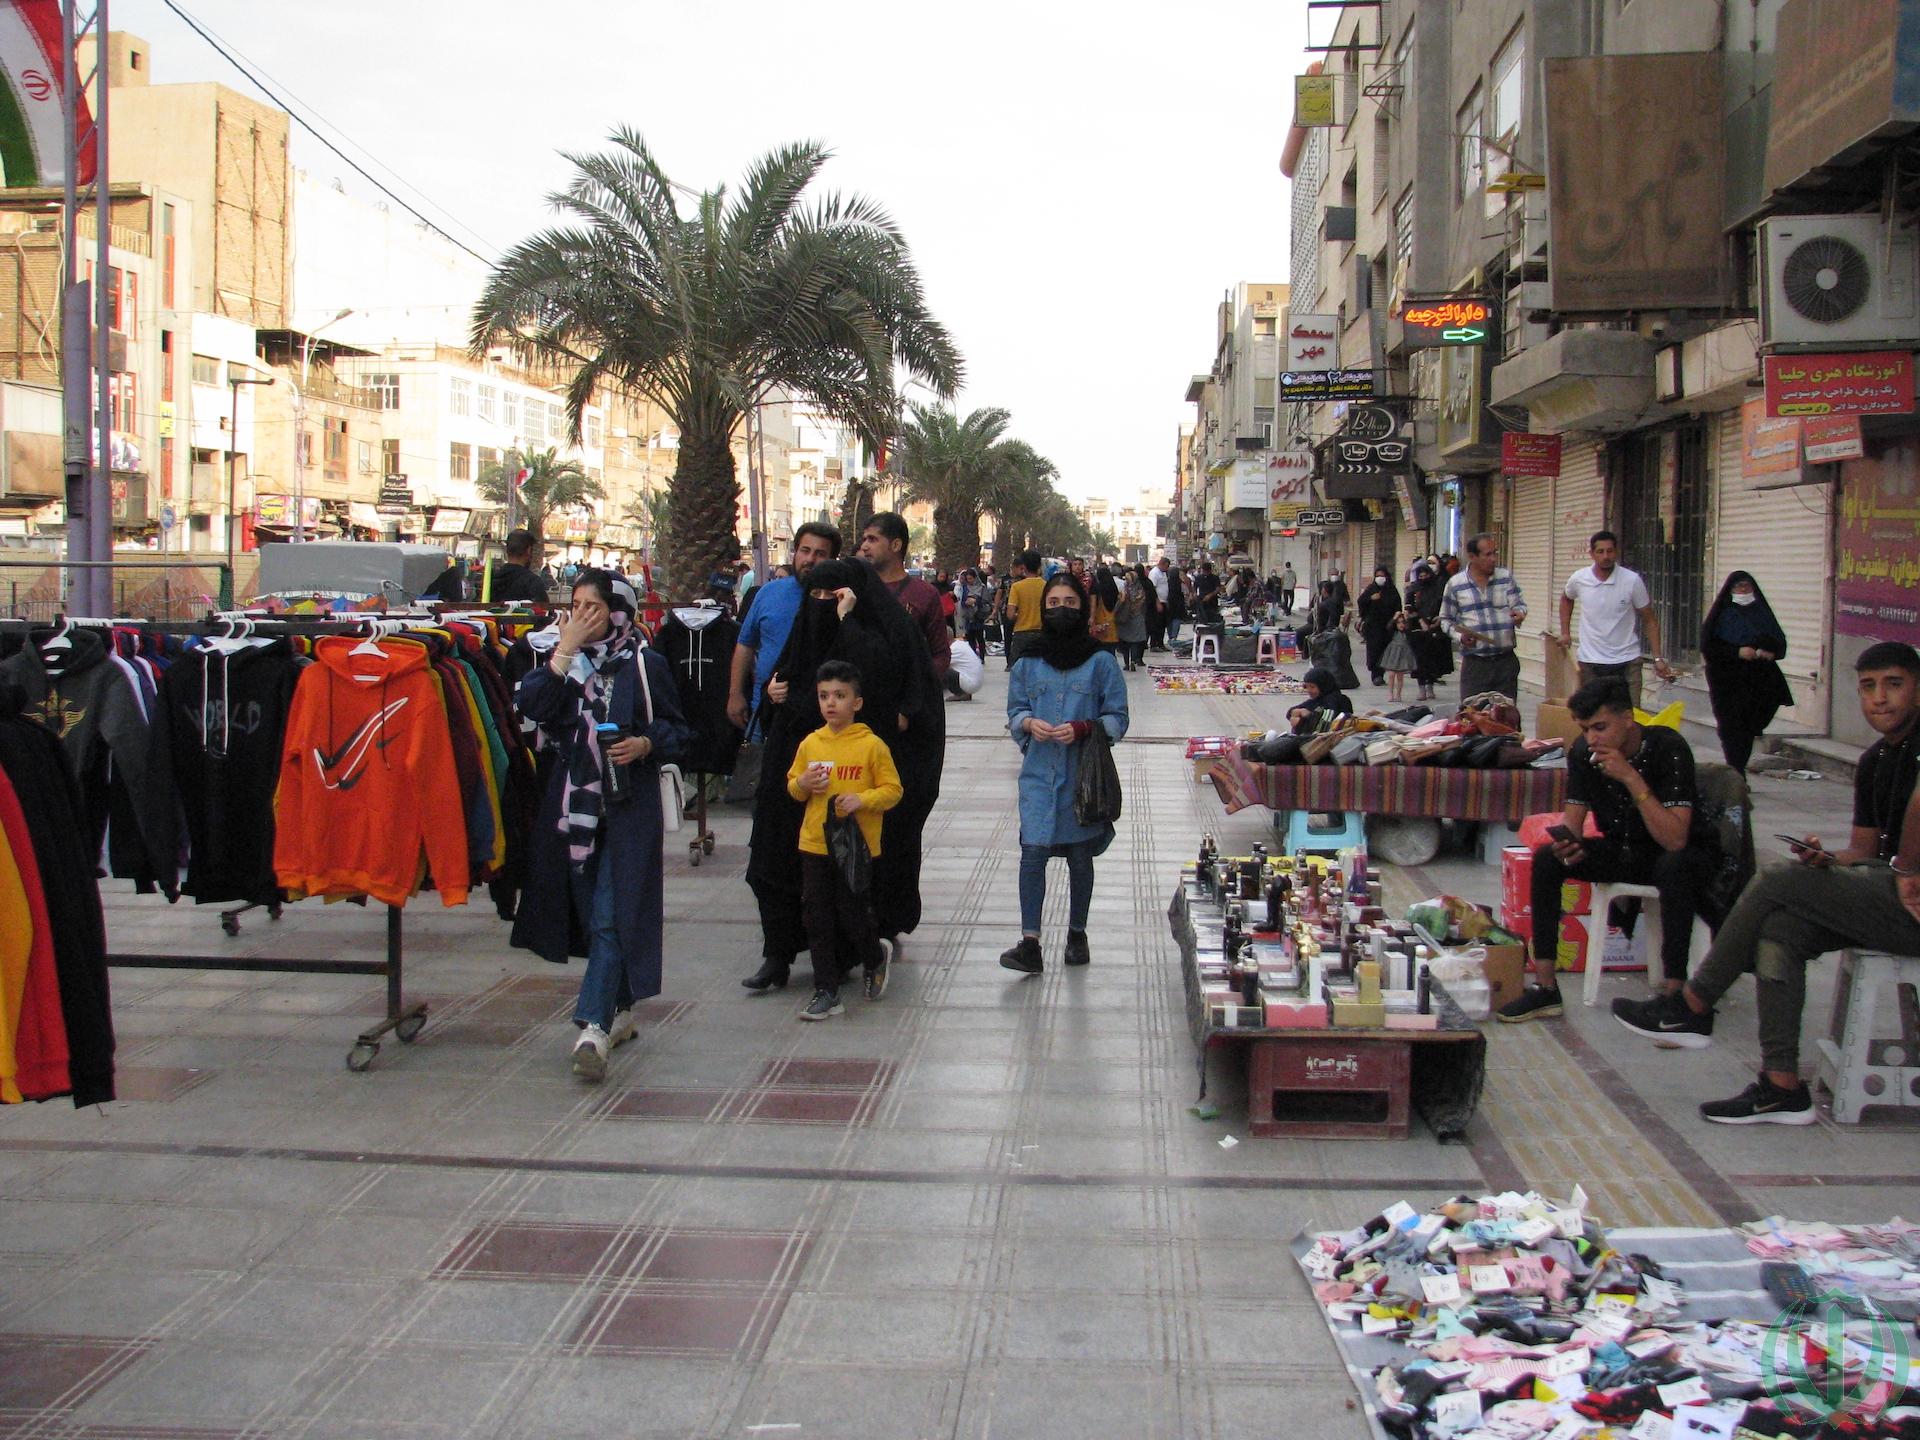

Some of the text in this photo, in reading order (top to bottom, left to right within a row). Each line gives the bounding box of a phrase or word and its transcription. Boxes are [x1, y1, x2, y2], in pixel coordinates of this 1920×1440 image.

[1291, 324, 1333, 339] سمعک
[1296, 346, 1325, 360] مهر
[1810, 368, 1842, 383] هنری
[1846, 360, 1903, 380] آموزشگاه
[1880, 385, 1897, 396] رنگ
[1380, 446, 1401, 458] عینک
[1269, 453, 1308, 469] داروخانه
